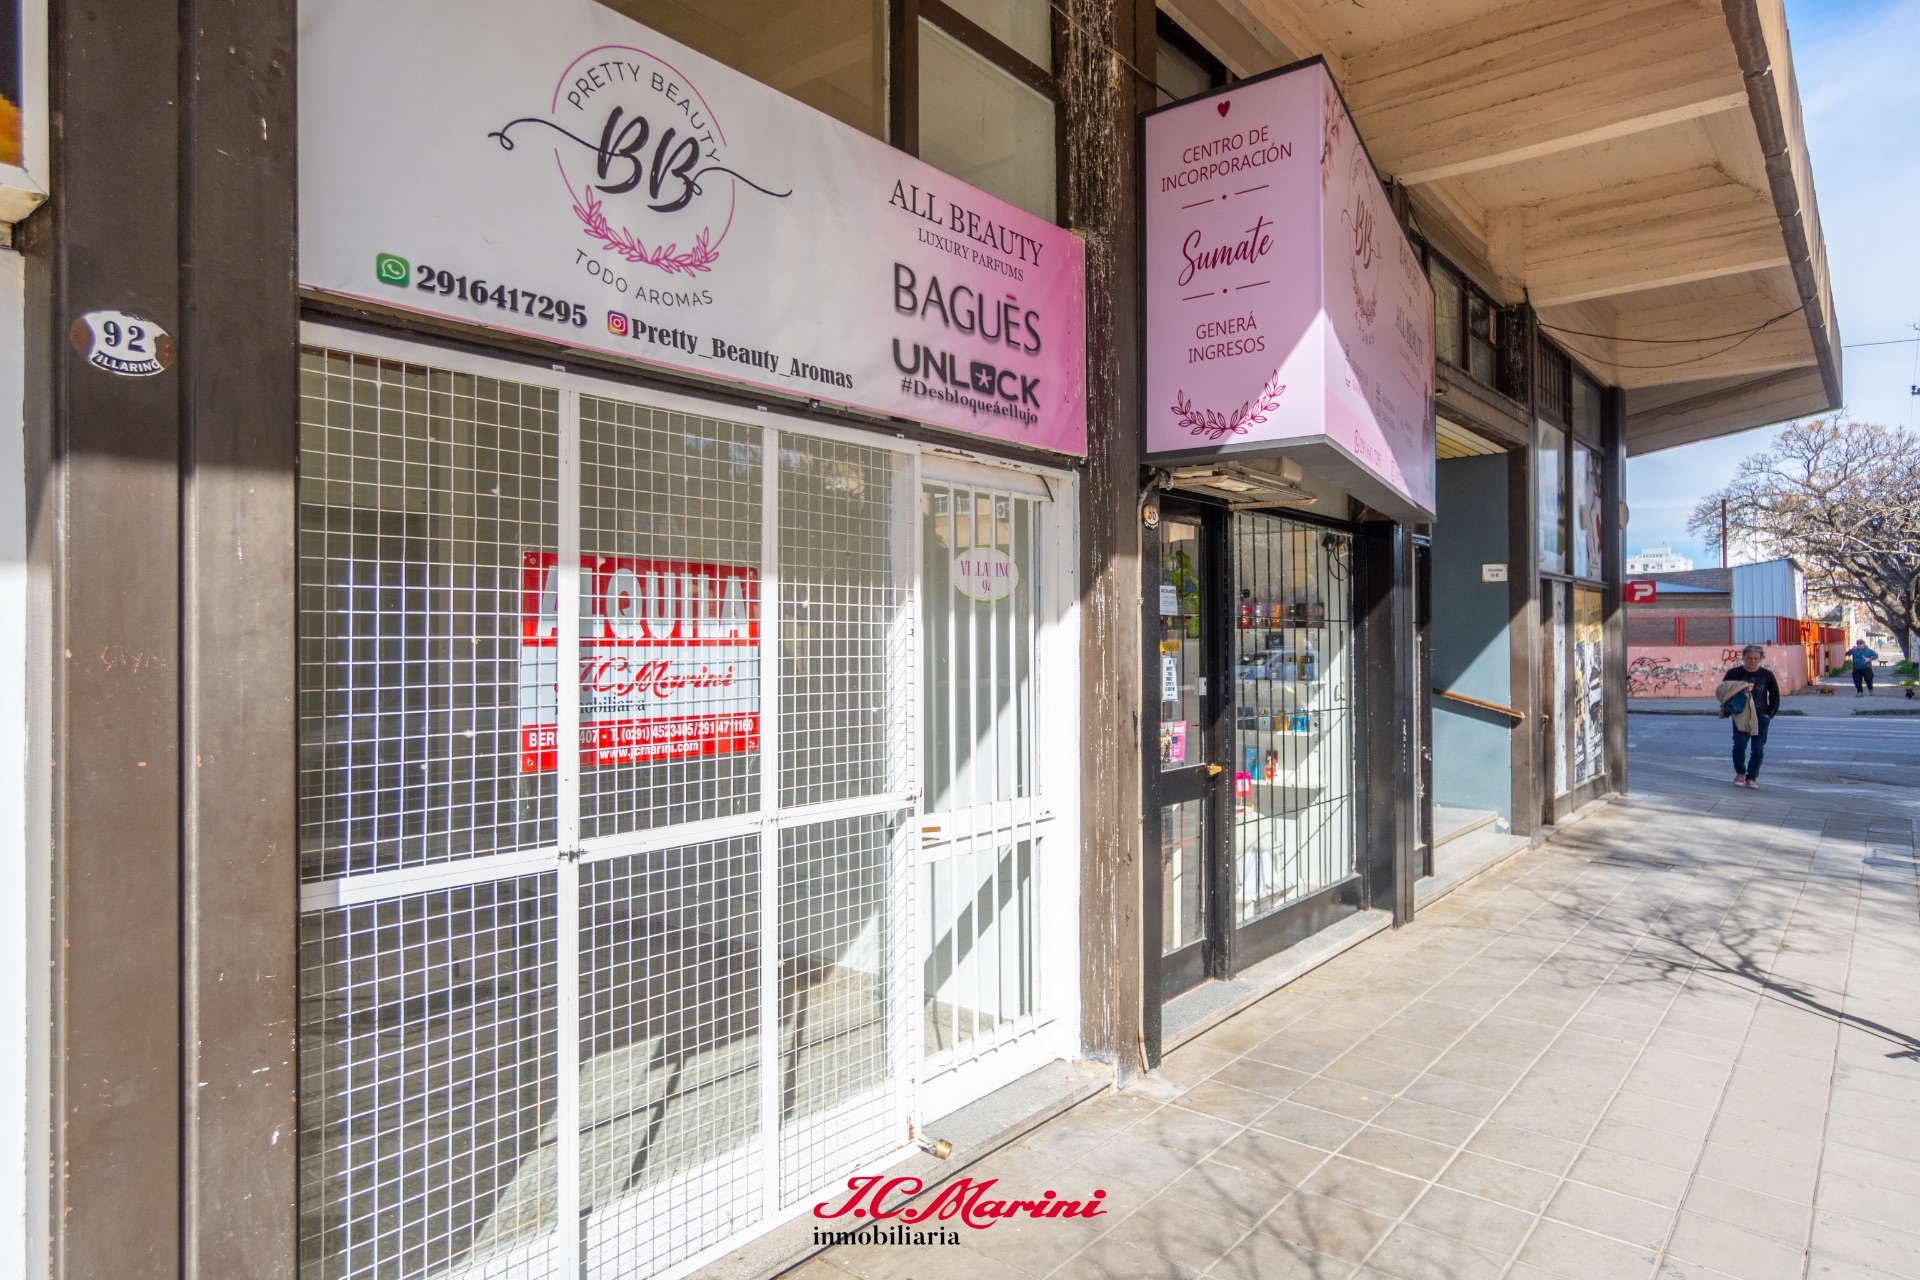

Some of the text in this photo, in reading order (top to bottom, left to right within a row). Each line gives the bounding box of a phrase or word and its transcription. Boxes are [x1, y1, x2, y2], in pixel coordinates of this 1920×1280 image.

[568, 62, 721, 163] PRETTY BEAUTY
[1161, 142, 1292, 193] INCORPORACIÓN
[1182, 126, 1270, 166] CENTRO DE
[889, 179, 1044, 267] ALL BEAUTY
[918, 228, 1025, 282] LUXURY PARFUMS
[1179, 216, 1274, 287] Sumate
[416, 264, 588, 328] 2916417295
[574, 248, 714, 308] TODO AROMAS
[103, 320, 147, 354] 92
[1188, 336, 1265, 364] INGRESOS
[1196, 311, 1258, 339] GENERÁ
[631, 317, 855, 391] Pretty_Beauty_Aromas
[900, 376, 1039, 427] #Desbloqueáellujo
[961, 560, 1011, 577] VILAINO
[535, 565, 750, 638] ALQUILA
[555, 696, 646, 716] iobiliaria
[600, 741, 699, 760] www.jcmarini.com
